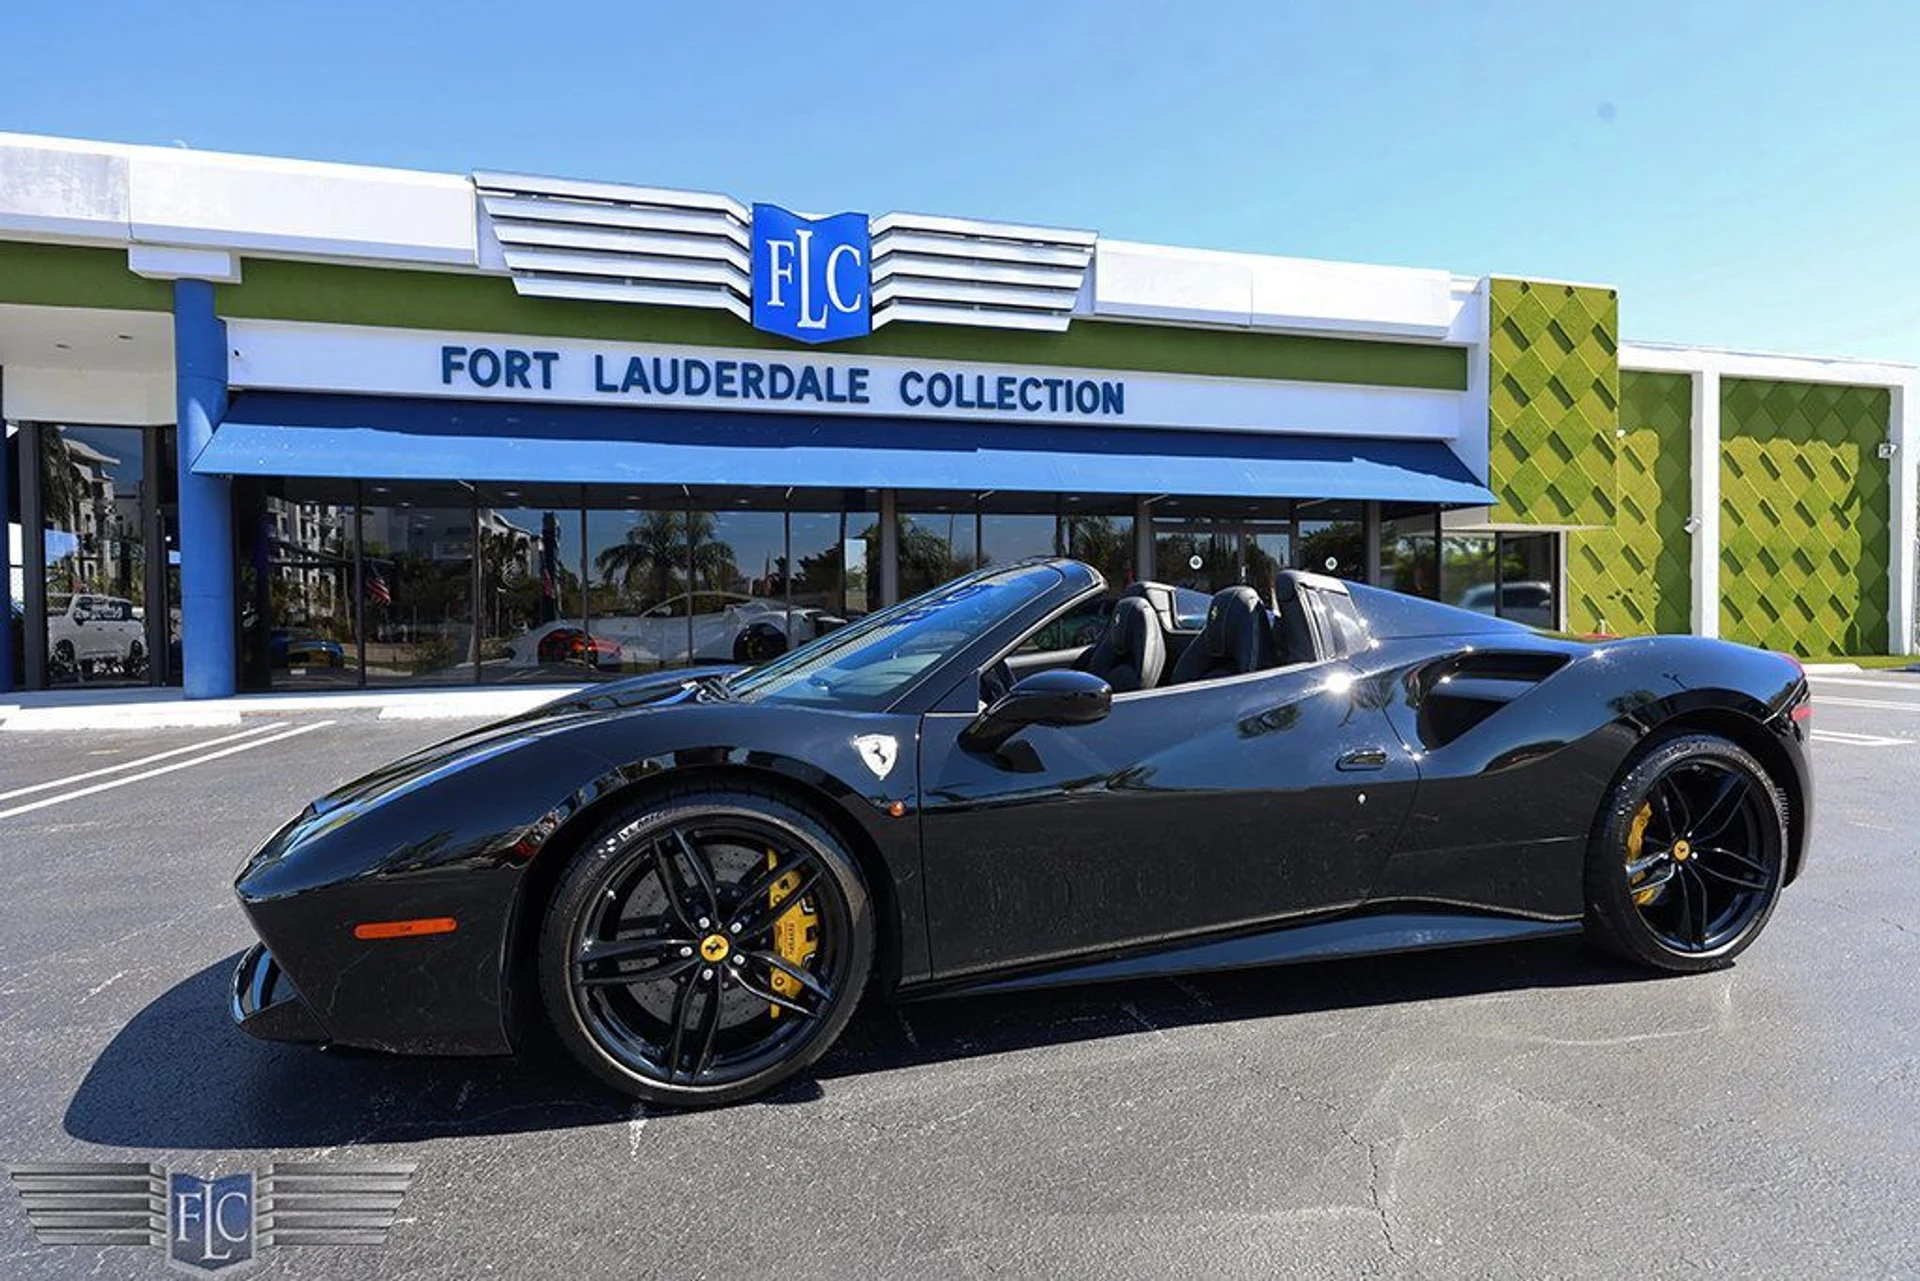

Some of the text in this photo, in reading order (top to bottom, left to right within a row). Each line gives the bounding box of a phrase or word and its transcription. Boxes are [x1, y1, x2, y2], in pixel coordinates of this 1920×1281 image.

[766, 228, 861, 329] FLC
[441, 346, 1125, 415] FORT LAUDERDALE COLLECTION
